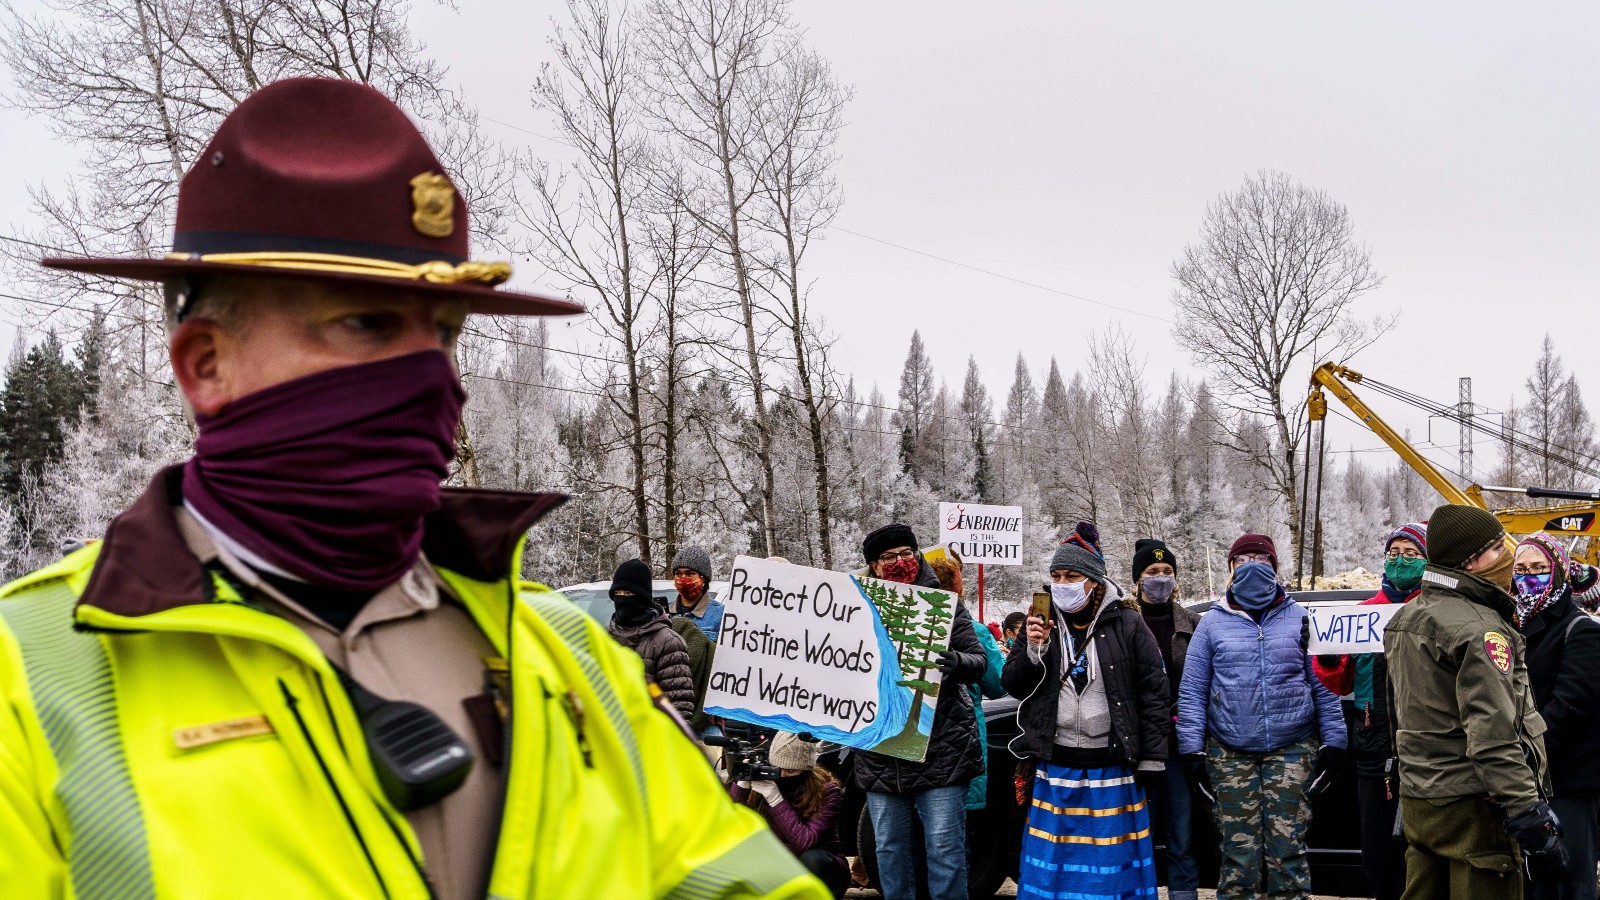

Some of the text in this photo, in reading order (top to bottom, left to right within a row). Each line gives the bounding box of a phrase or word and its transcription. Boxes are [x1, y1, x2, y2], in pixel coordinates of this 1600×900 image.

[957, 514, 1021, 532] ENBRIDGE
[1561, 517, 1583, 531] CAT
[970, 533, 978, 541] IS
[948, 541, 1020, 559] CULPRIT
[729, 568, 861, 623] Protect Our
[719, 612, 874, 673] Pristine Woods
[710, 666, 877, 733] and Waterways
